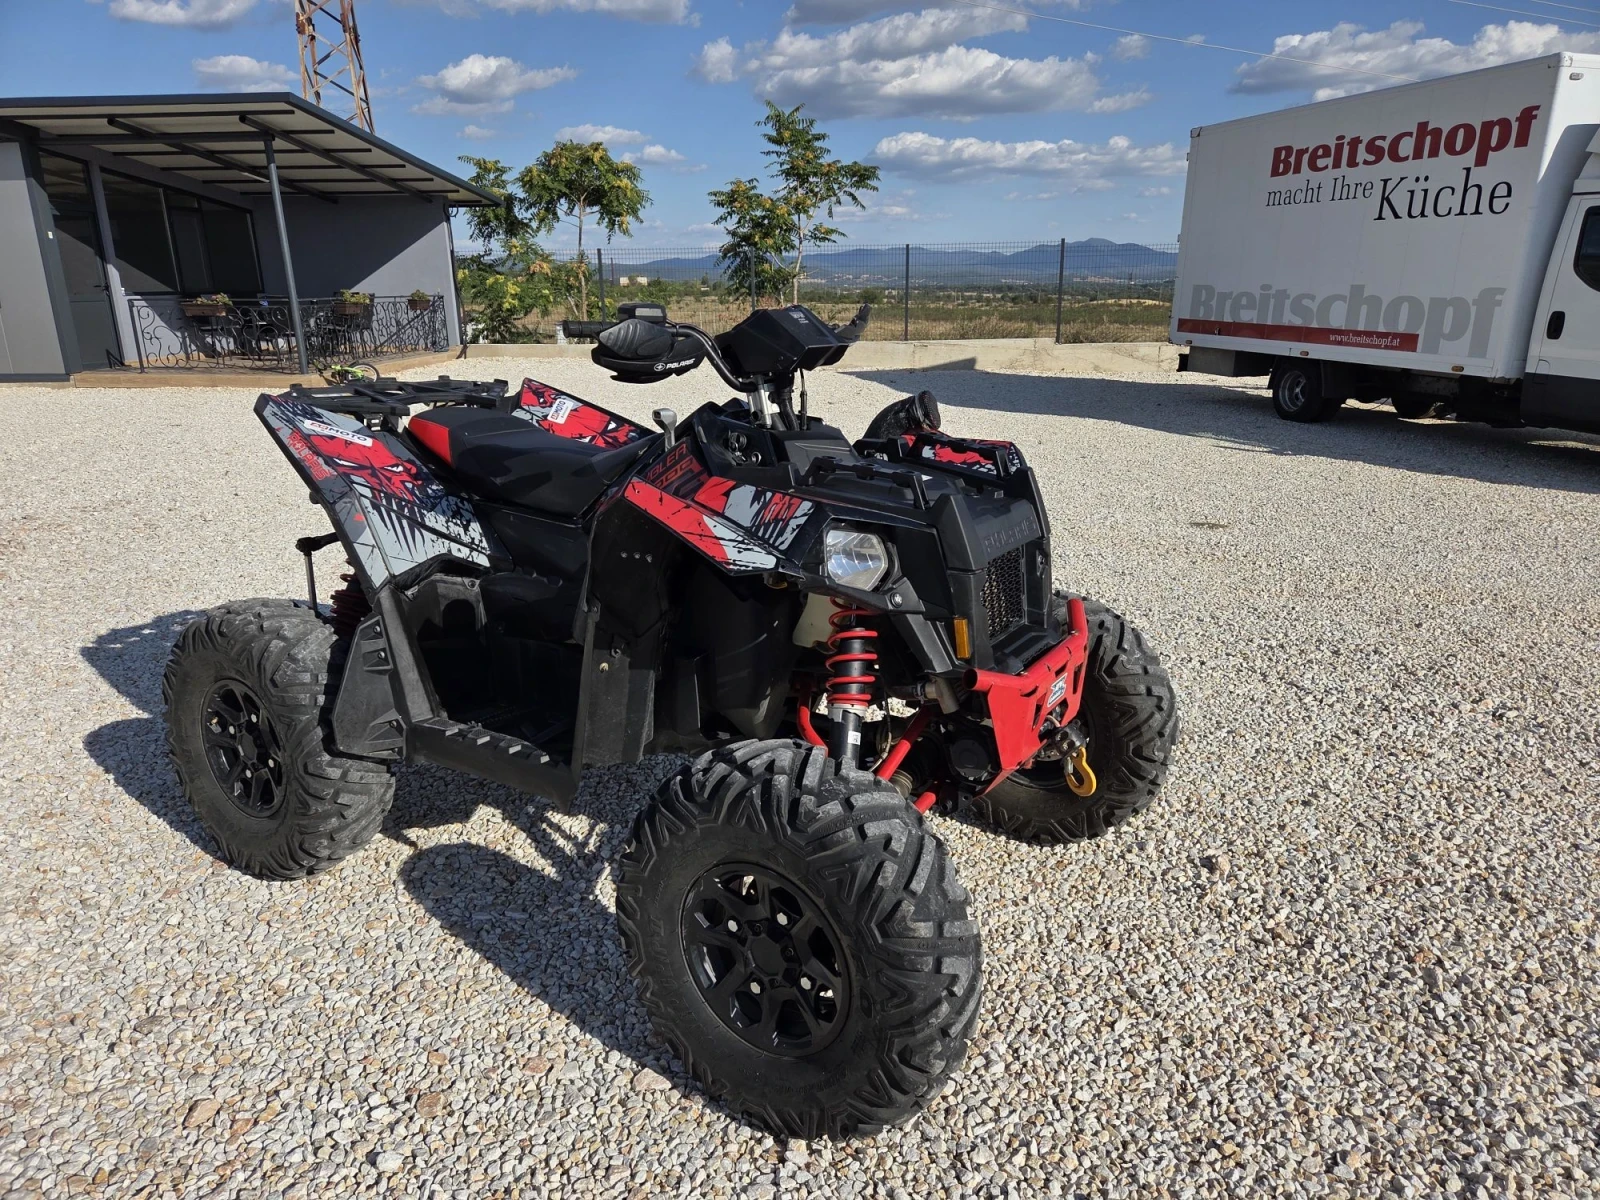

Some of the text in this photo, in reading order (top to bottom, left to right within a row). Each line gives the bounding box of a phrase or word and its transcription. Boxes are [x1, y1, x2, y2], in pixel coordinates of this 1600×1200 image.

[1270, 105, 1540, 178] Breitschopf
[1265, 167, 1513, 221] macht Ihre Küche
[1191, 284, 1507, 358] Breitschopf
[1329, 332, 1401, 349] www.breitschopf.at
[666, 358, 696, 369] POLARIS
